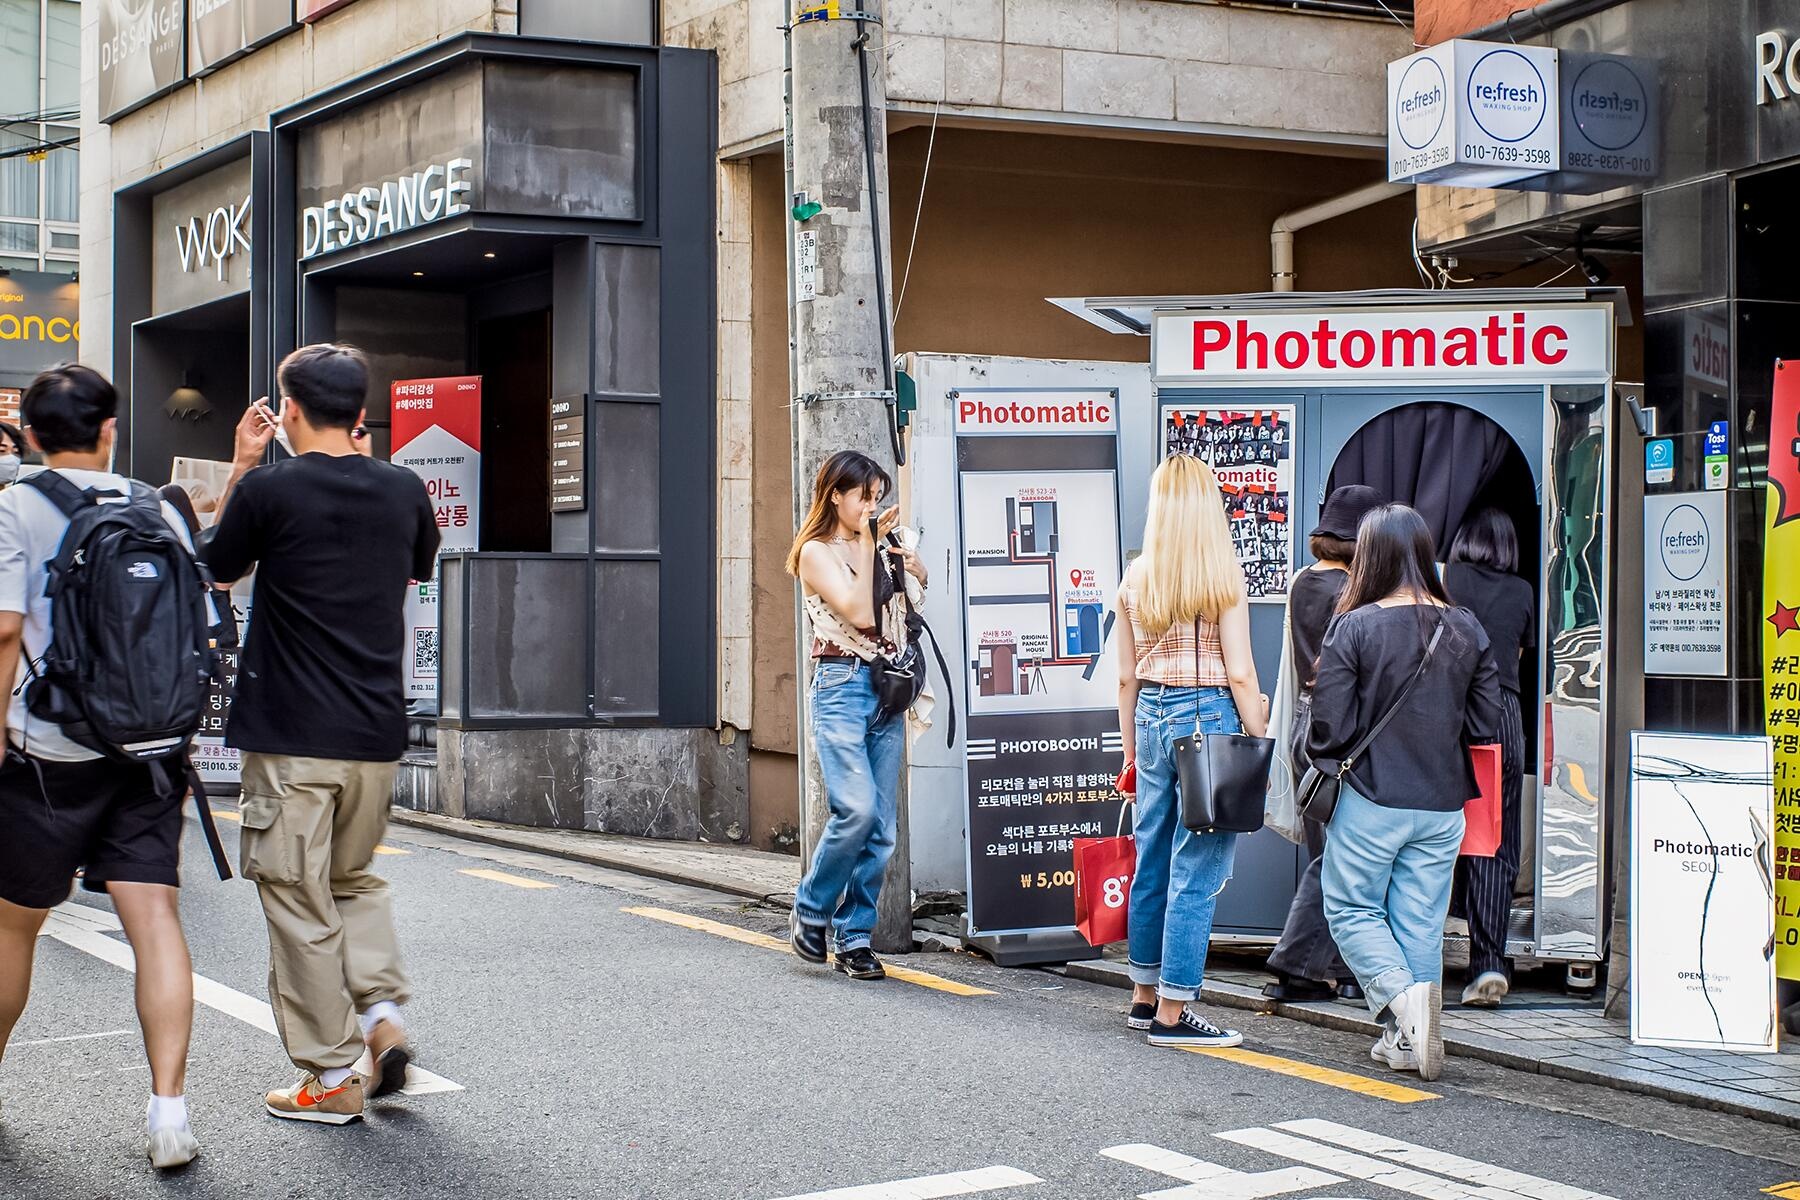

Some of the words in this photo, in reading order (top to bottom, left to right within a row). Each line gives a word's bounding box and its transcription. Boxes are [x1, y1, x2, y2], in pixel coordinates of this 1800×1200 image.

[102, 1, 178, 71] DESSANGE
[1483, 102, 1511, 110] WAXING
[1513, 103, 1532, 112] SHOP
[1394, 146, 1450, 175] 010-7639-3598
[1464, 144, 1551, 164] 010-7639-3598
[303, 157, 473, 259] DESSANGE
[1192, 312, 1569, 371] Photomatic
[395, 384, 434, 396] #파리감성
[395, 398, 433, 410] #헤어맛집
[959, 401, 1110, 424] Photomatic
[1707, 433, 1726, 444] Toss
[1649, 643, 1658, 653] 3F
[1681, 644, 1722, 653] 010.7639.3598
[1000, 738, 1098, 754] PHOTOBOOTH
[981, 777, 1025, 792] 리모컨을
[1028, 776, 1049, 790] 눌러
[1052, 775, 1074, 789] 직접
[977, 792, 1043, 808] 포토매틱만의
[1045, 791, 1073, 804] 4가지
[1002, 824, 1035, 839] 색다른
[1038, 822, 1102, 837] 포토부스에서
[985, 842, 1019, 856] 오늘의
[1021, 841, 1044, 855] 나를
[1654, 839, 1753, 858] Photomatic
[1681, 860, 1724, 874] SEOUL
[1677, 971, 1702, 980] OPEN
